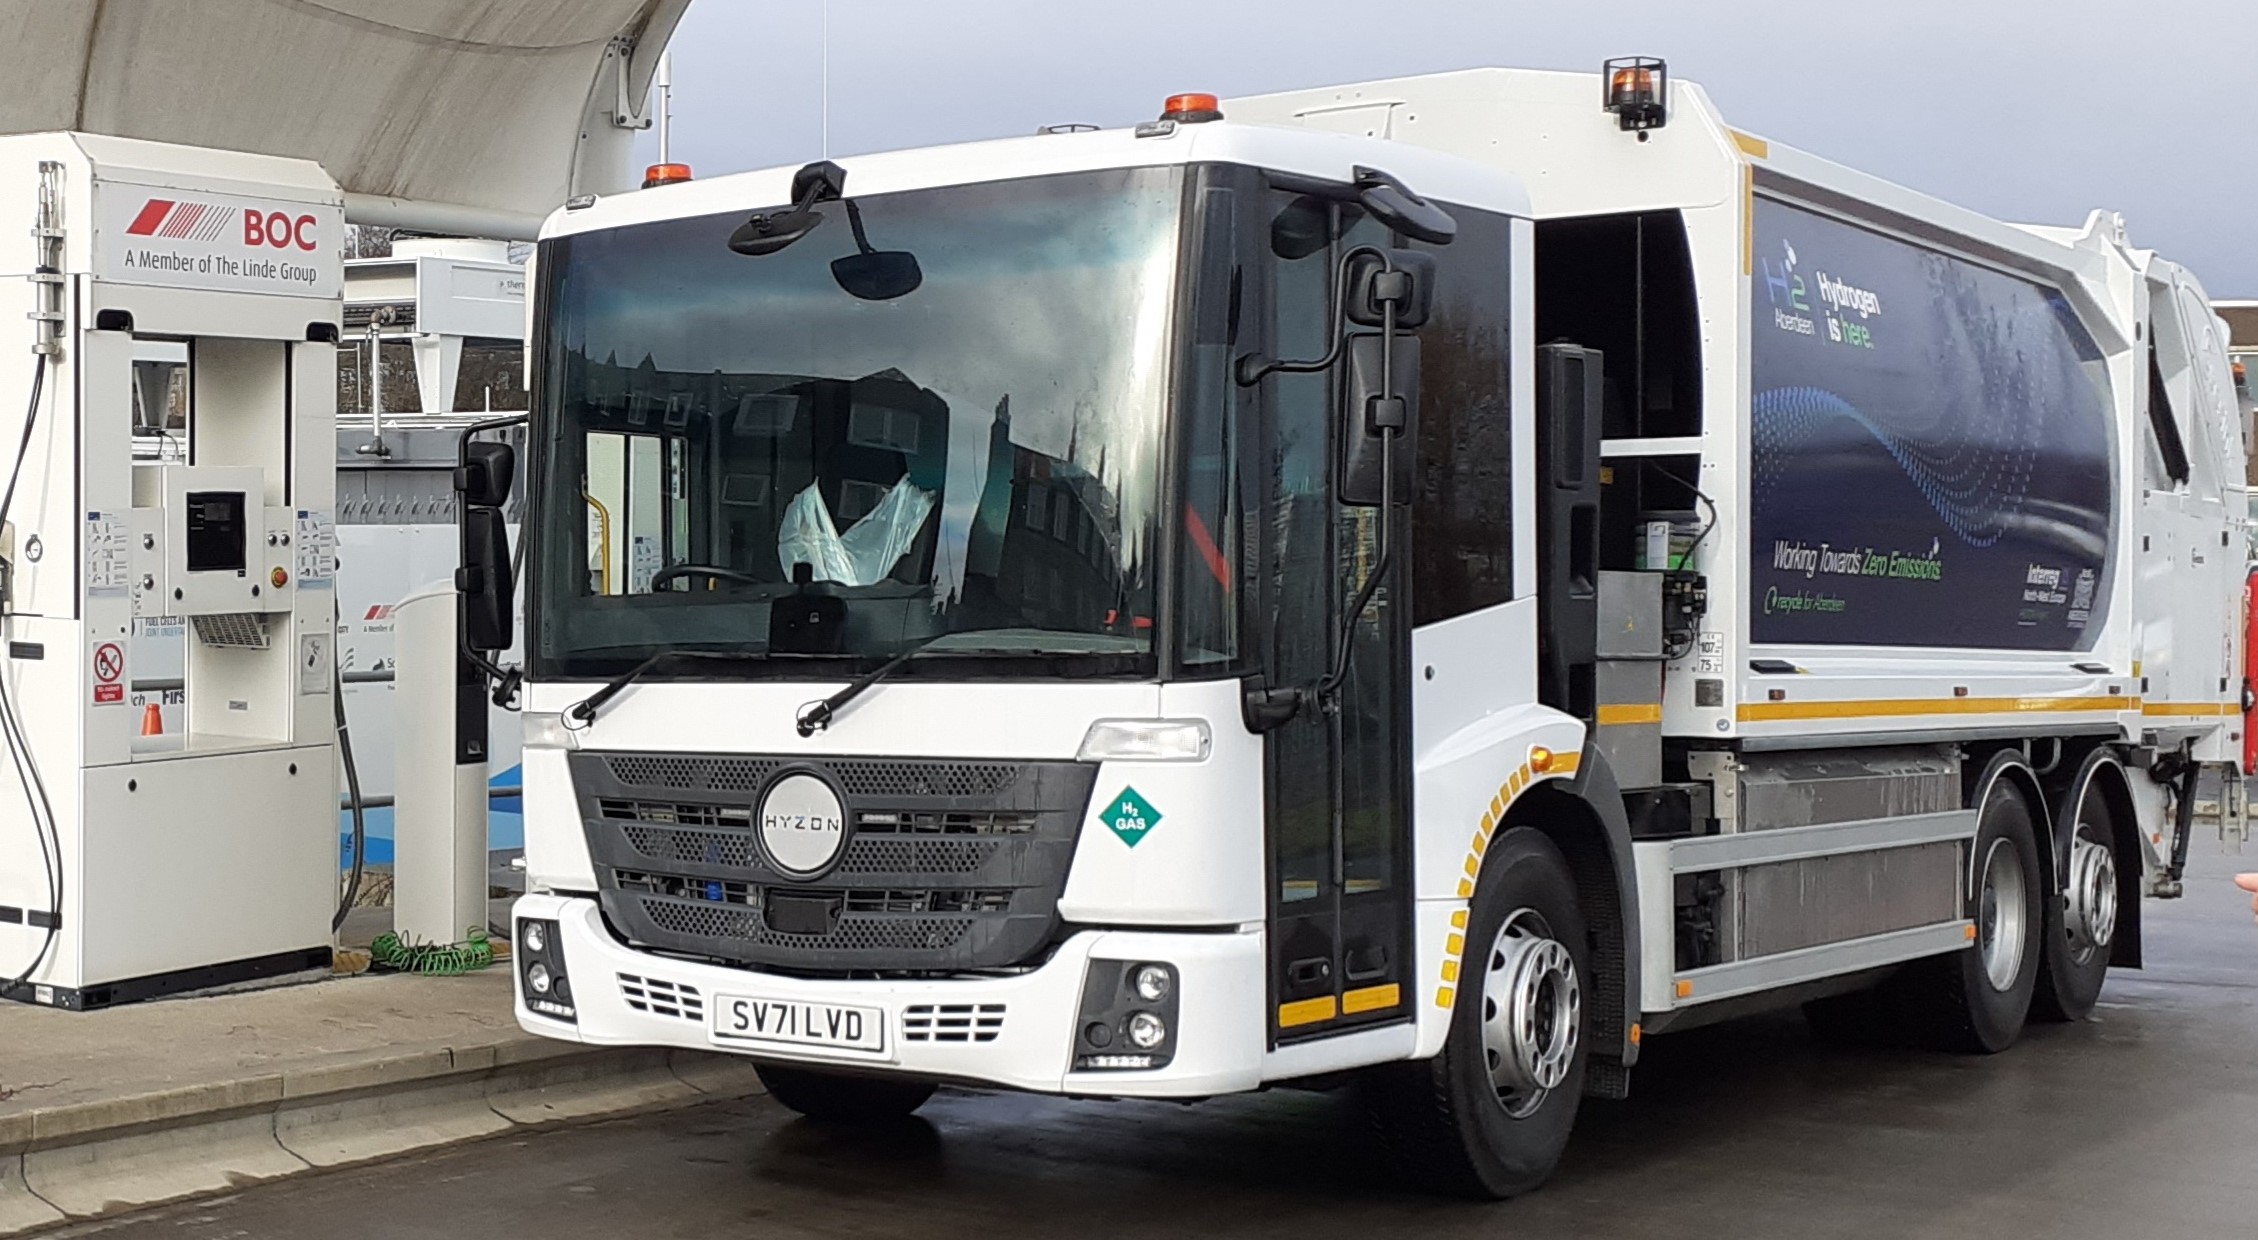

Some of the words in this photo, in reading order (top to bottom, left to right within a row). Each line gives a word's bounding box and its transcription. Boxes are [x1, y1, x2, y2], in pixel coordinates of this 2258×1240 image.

[244, 208, 317, 251] BOC
[124, 249, 135, 267] A
[139, 250, 194, 271] Member
[199, 254, 212, 273] of
[215, 256, 239, 276] The
[243, 258, 276, 279] Linde
[280, 262, 317, 286] Group
[507, 280, 525, 289] ther
[1762, 257, 1810, 312] H2
[1816, 270, 1881, 319] Hydrogen
[1775, 307, 1815, 335] Aberdeen
[1825, 309, 1841, 342] is
[1840, 312, 1874, 349] here.
[1773, 540, 1817, 579] Working
[1819, 544, 1862, 575] Towards
[1861, 548, 1888, 576] Zero
[1700, 659, 1711, 671] 75
[765, 815, 840, 832] HYZON
[1115, 817, 1146, 830] GAS
[1122, 801, 1139, 817] H2
[733, 1000, 796, 1036] SV71
[805, 1006, 863, 1042] LVD
